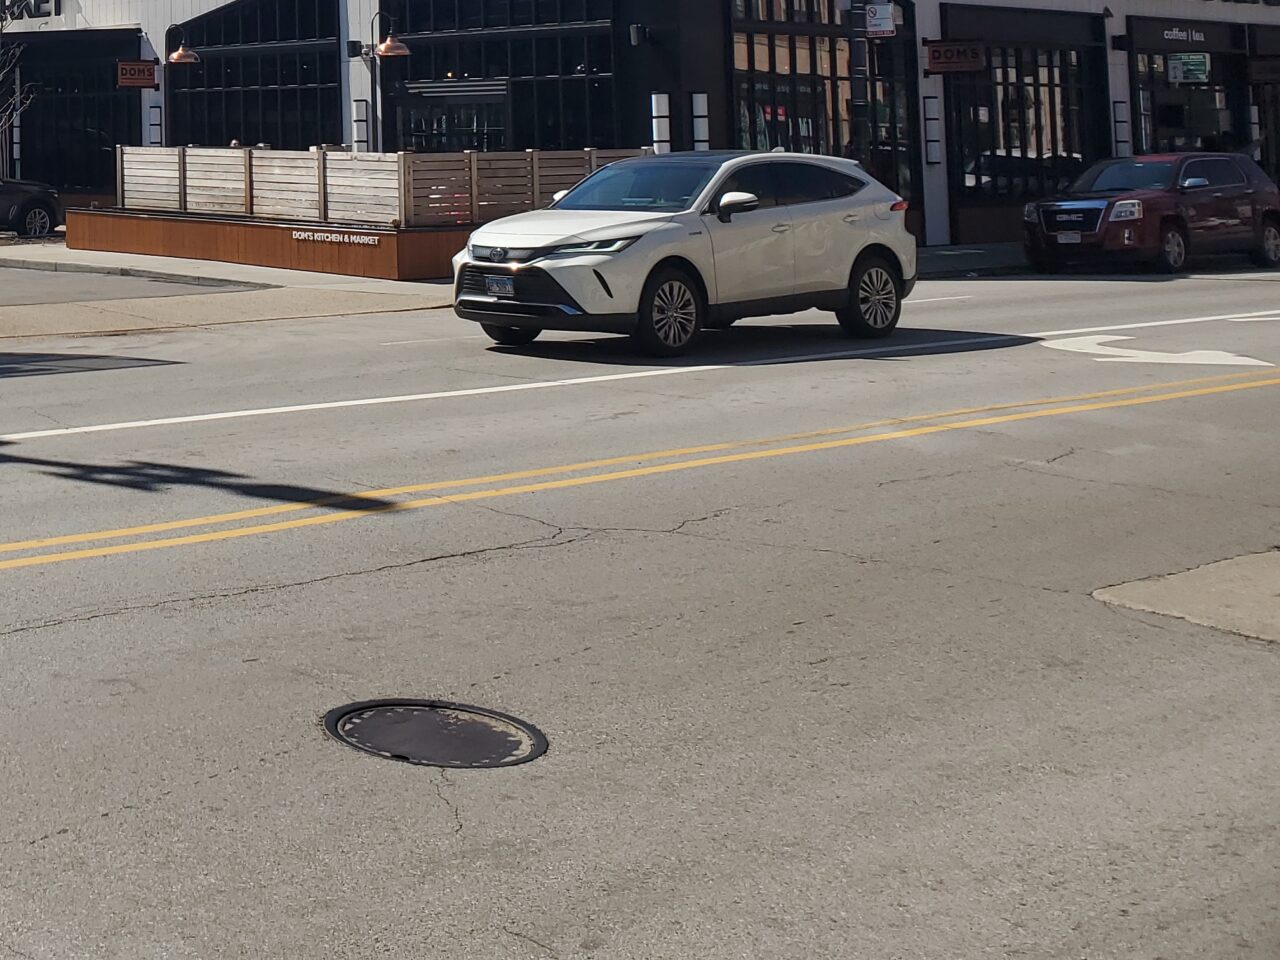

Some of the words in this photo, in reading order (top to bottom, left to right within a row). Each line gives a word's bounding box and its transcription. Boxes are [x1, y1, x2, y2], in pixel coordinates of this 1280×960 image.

[1164, 28, 1187, 40] coffee
[1193, 29, 1206, 41] tea
[292, 231, 314, 241] DOM'S
[314, 232, 344, 243] KITCHEN
[350, 235, 379, 246] MARKET
